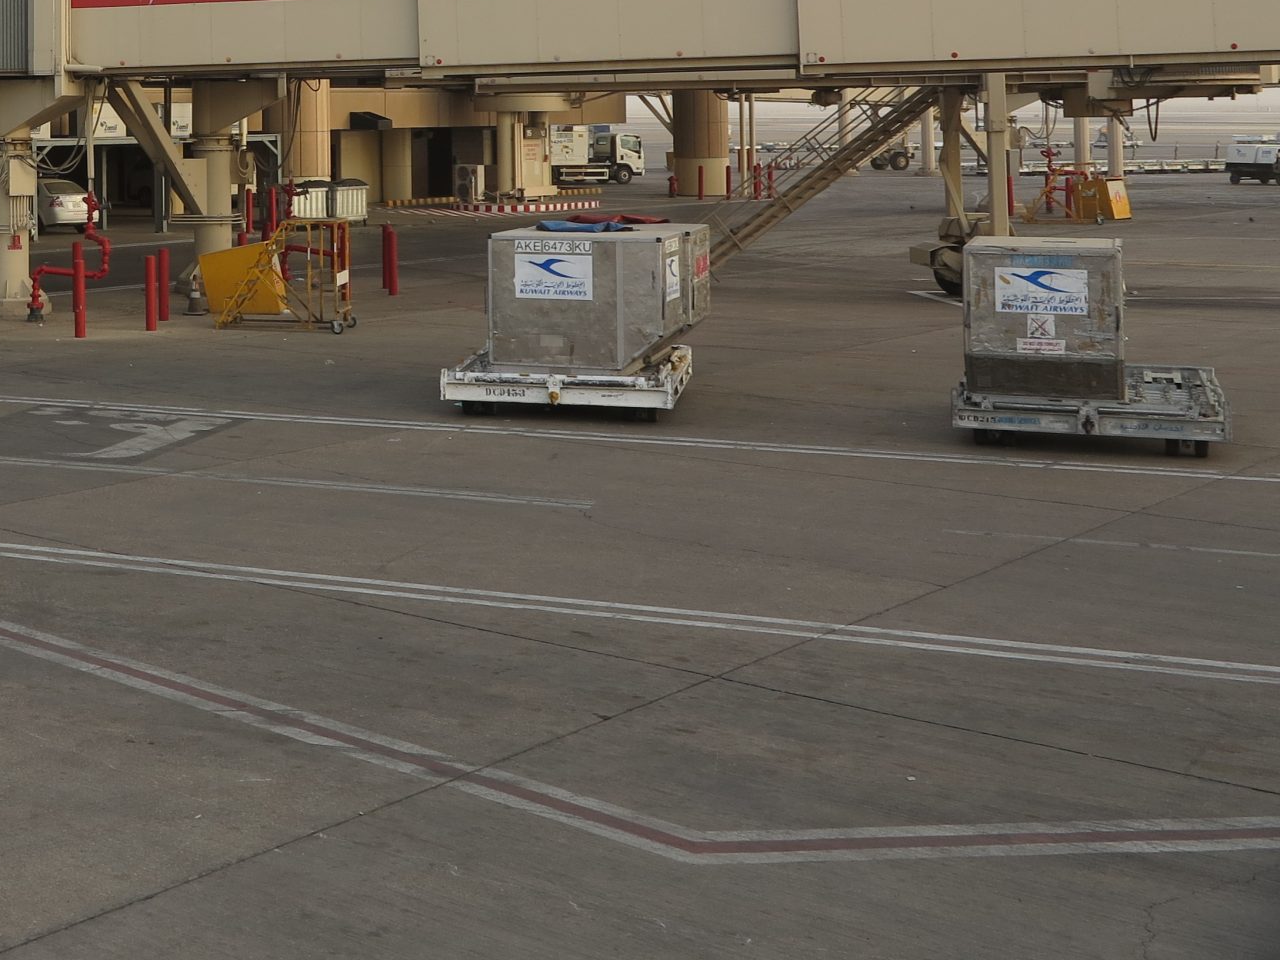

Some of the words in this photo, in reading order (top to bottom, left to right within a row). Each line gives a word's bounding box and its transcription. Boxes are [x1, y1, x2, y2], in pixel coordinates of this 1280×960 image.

[515, 241, 541, 251] AKE
[543, 241, 573, 252] 6473
[574, 242, 592, 252] KU
[1001, 303, 1039, 312] KUWAIT
[1042, 304, 1086, 313] AIRWAYS
